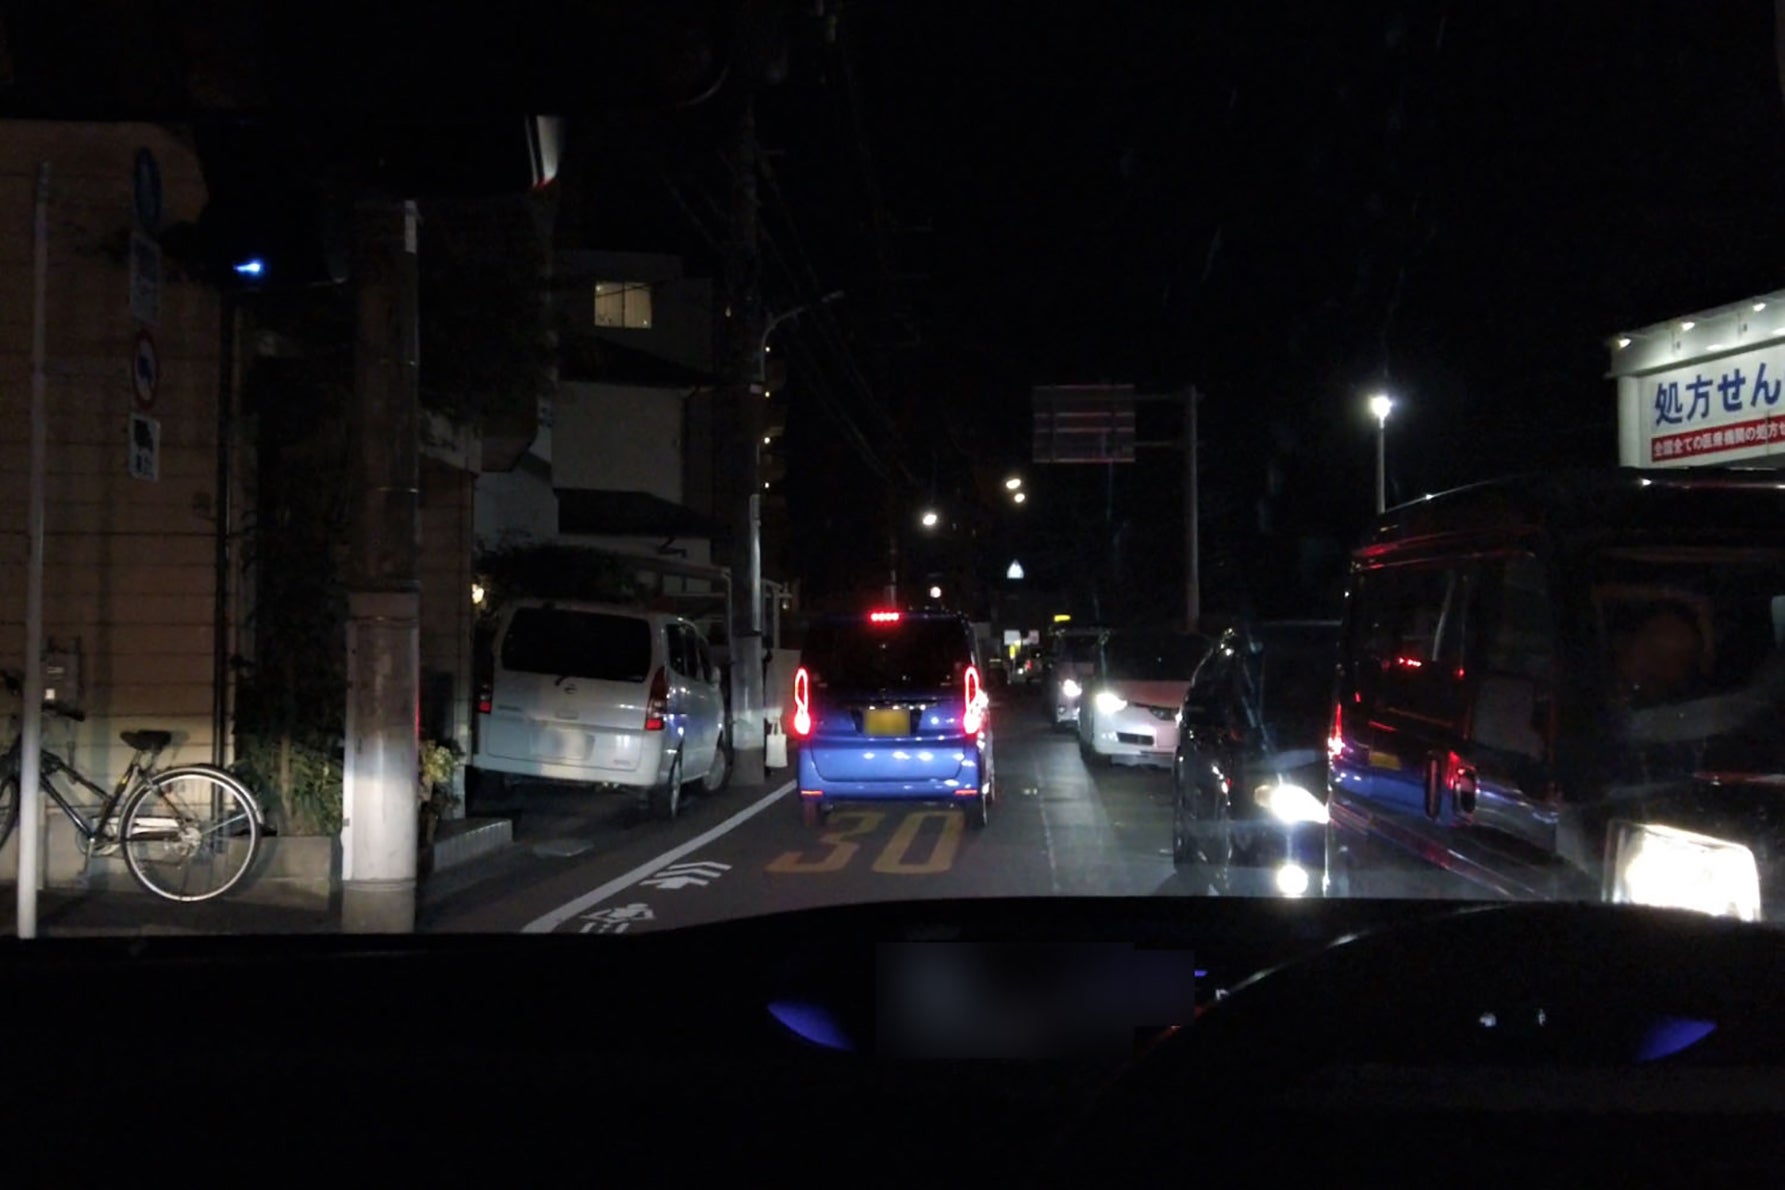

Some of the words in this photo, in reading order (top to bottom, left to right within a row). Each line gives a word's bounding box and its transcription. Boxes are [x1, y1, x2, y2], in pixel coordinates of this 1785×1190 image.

[1655, 362, 1782, 427] 処方せん
[764, 810, 965, 874] 30
